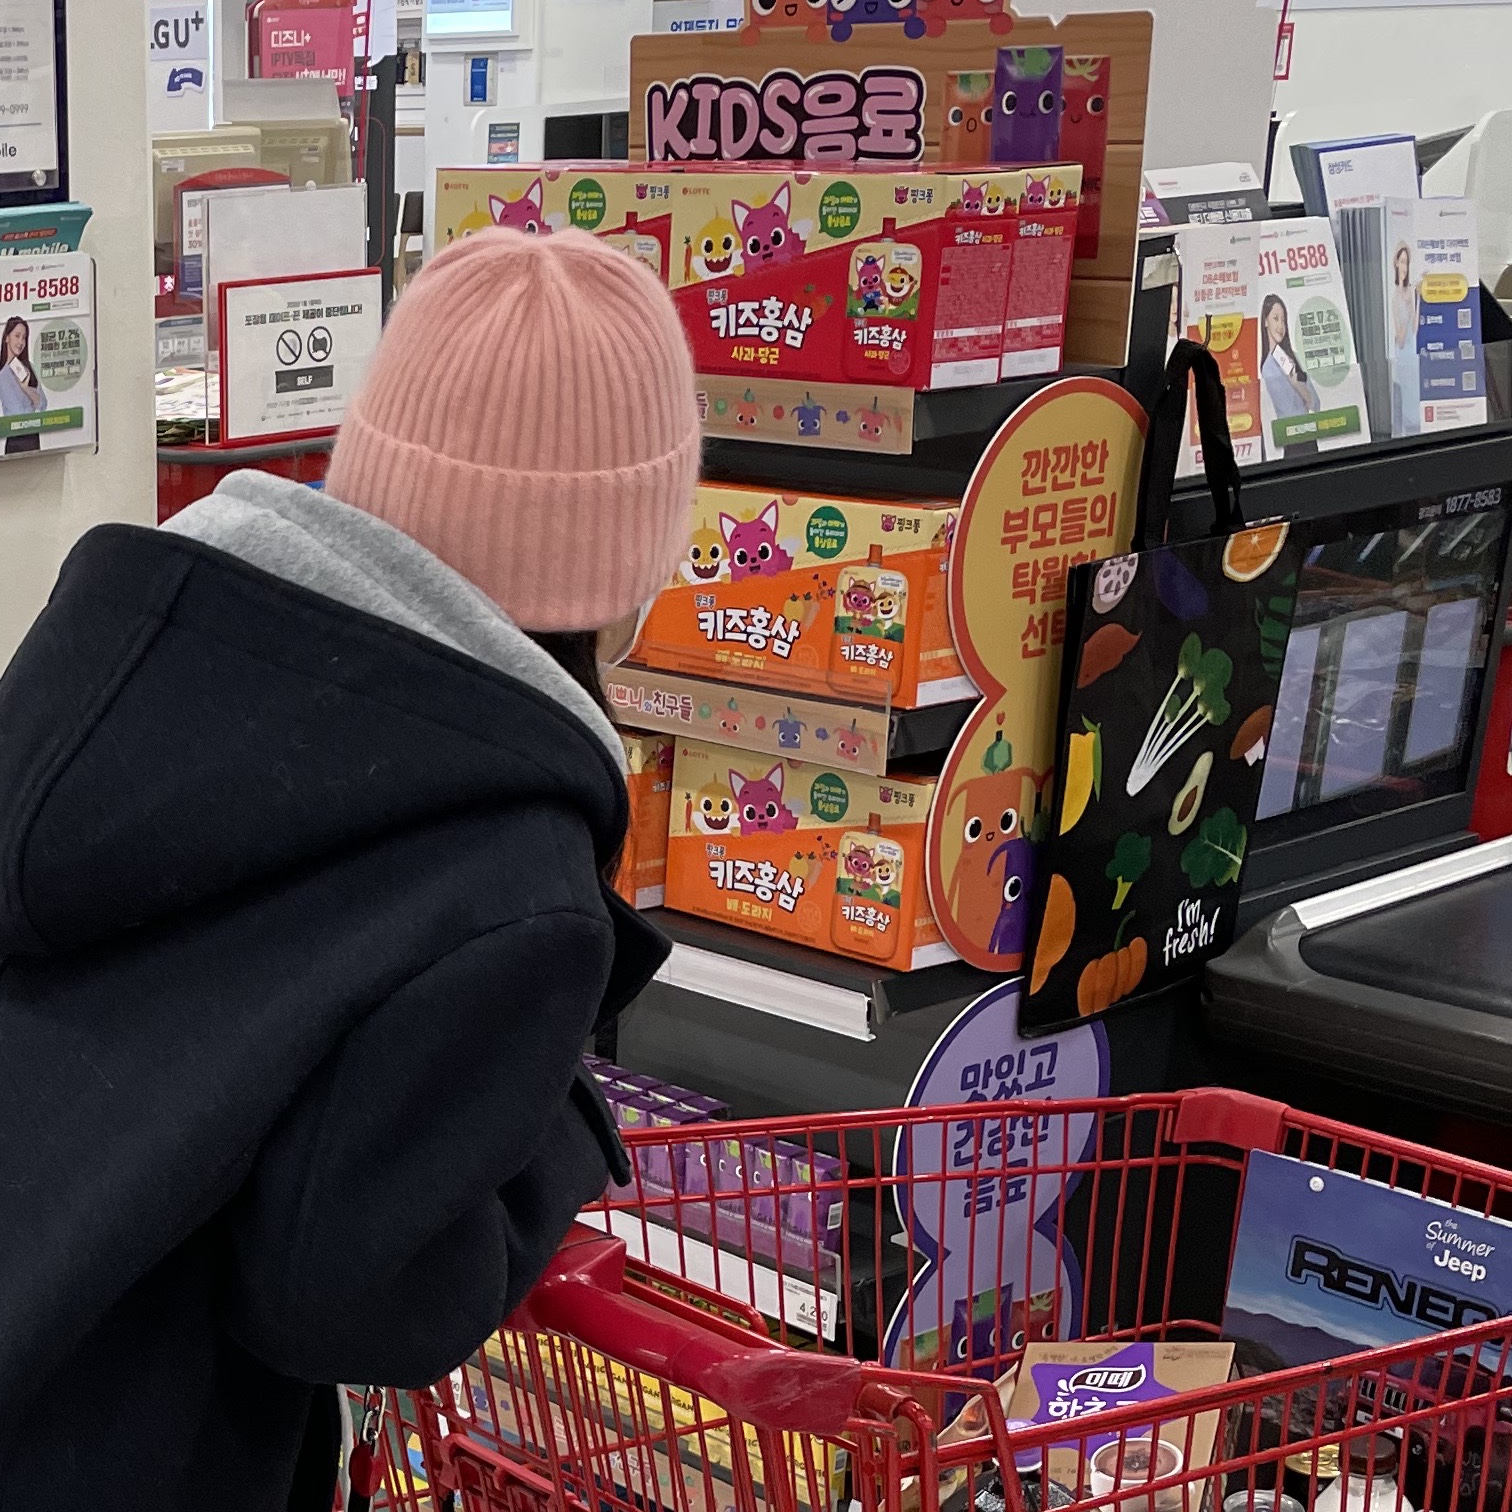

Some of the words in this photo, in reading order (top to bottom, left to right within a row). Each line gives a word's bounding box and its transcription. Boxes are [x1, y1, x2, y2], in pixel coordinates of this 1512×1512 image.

[709, 296, 813, 349] 키즈홍삼
[853, 325, 907, 350] 키즈홍삼
[1021, 439, 1109, 497] 깐깐한
[1000, 491, 1117, 555] 부모들의
[697, 604, 801, 659] 키즈홍삼
[840, 643, 894, 669] 키즈홍삼
[652, 690, 693, 721] 친구들
[708, 858, 805, 913] 키즈홍삼
[841, 904, 892, 932] 키즈홍삼
[1177, 899, 1202, 933] I'm
[1162, 906, 1221, 967] fresh!
[1425, 1220, 1496, 1258] Summer
[1444, 1218, 1458, 1230] the
[1434, 1248, 1487, 1283] Jeep
[799, 1302, 828, 1323] 4,20
